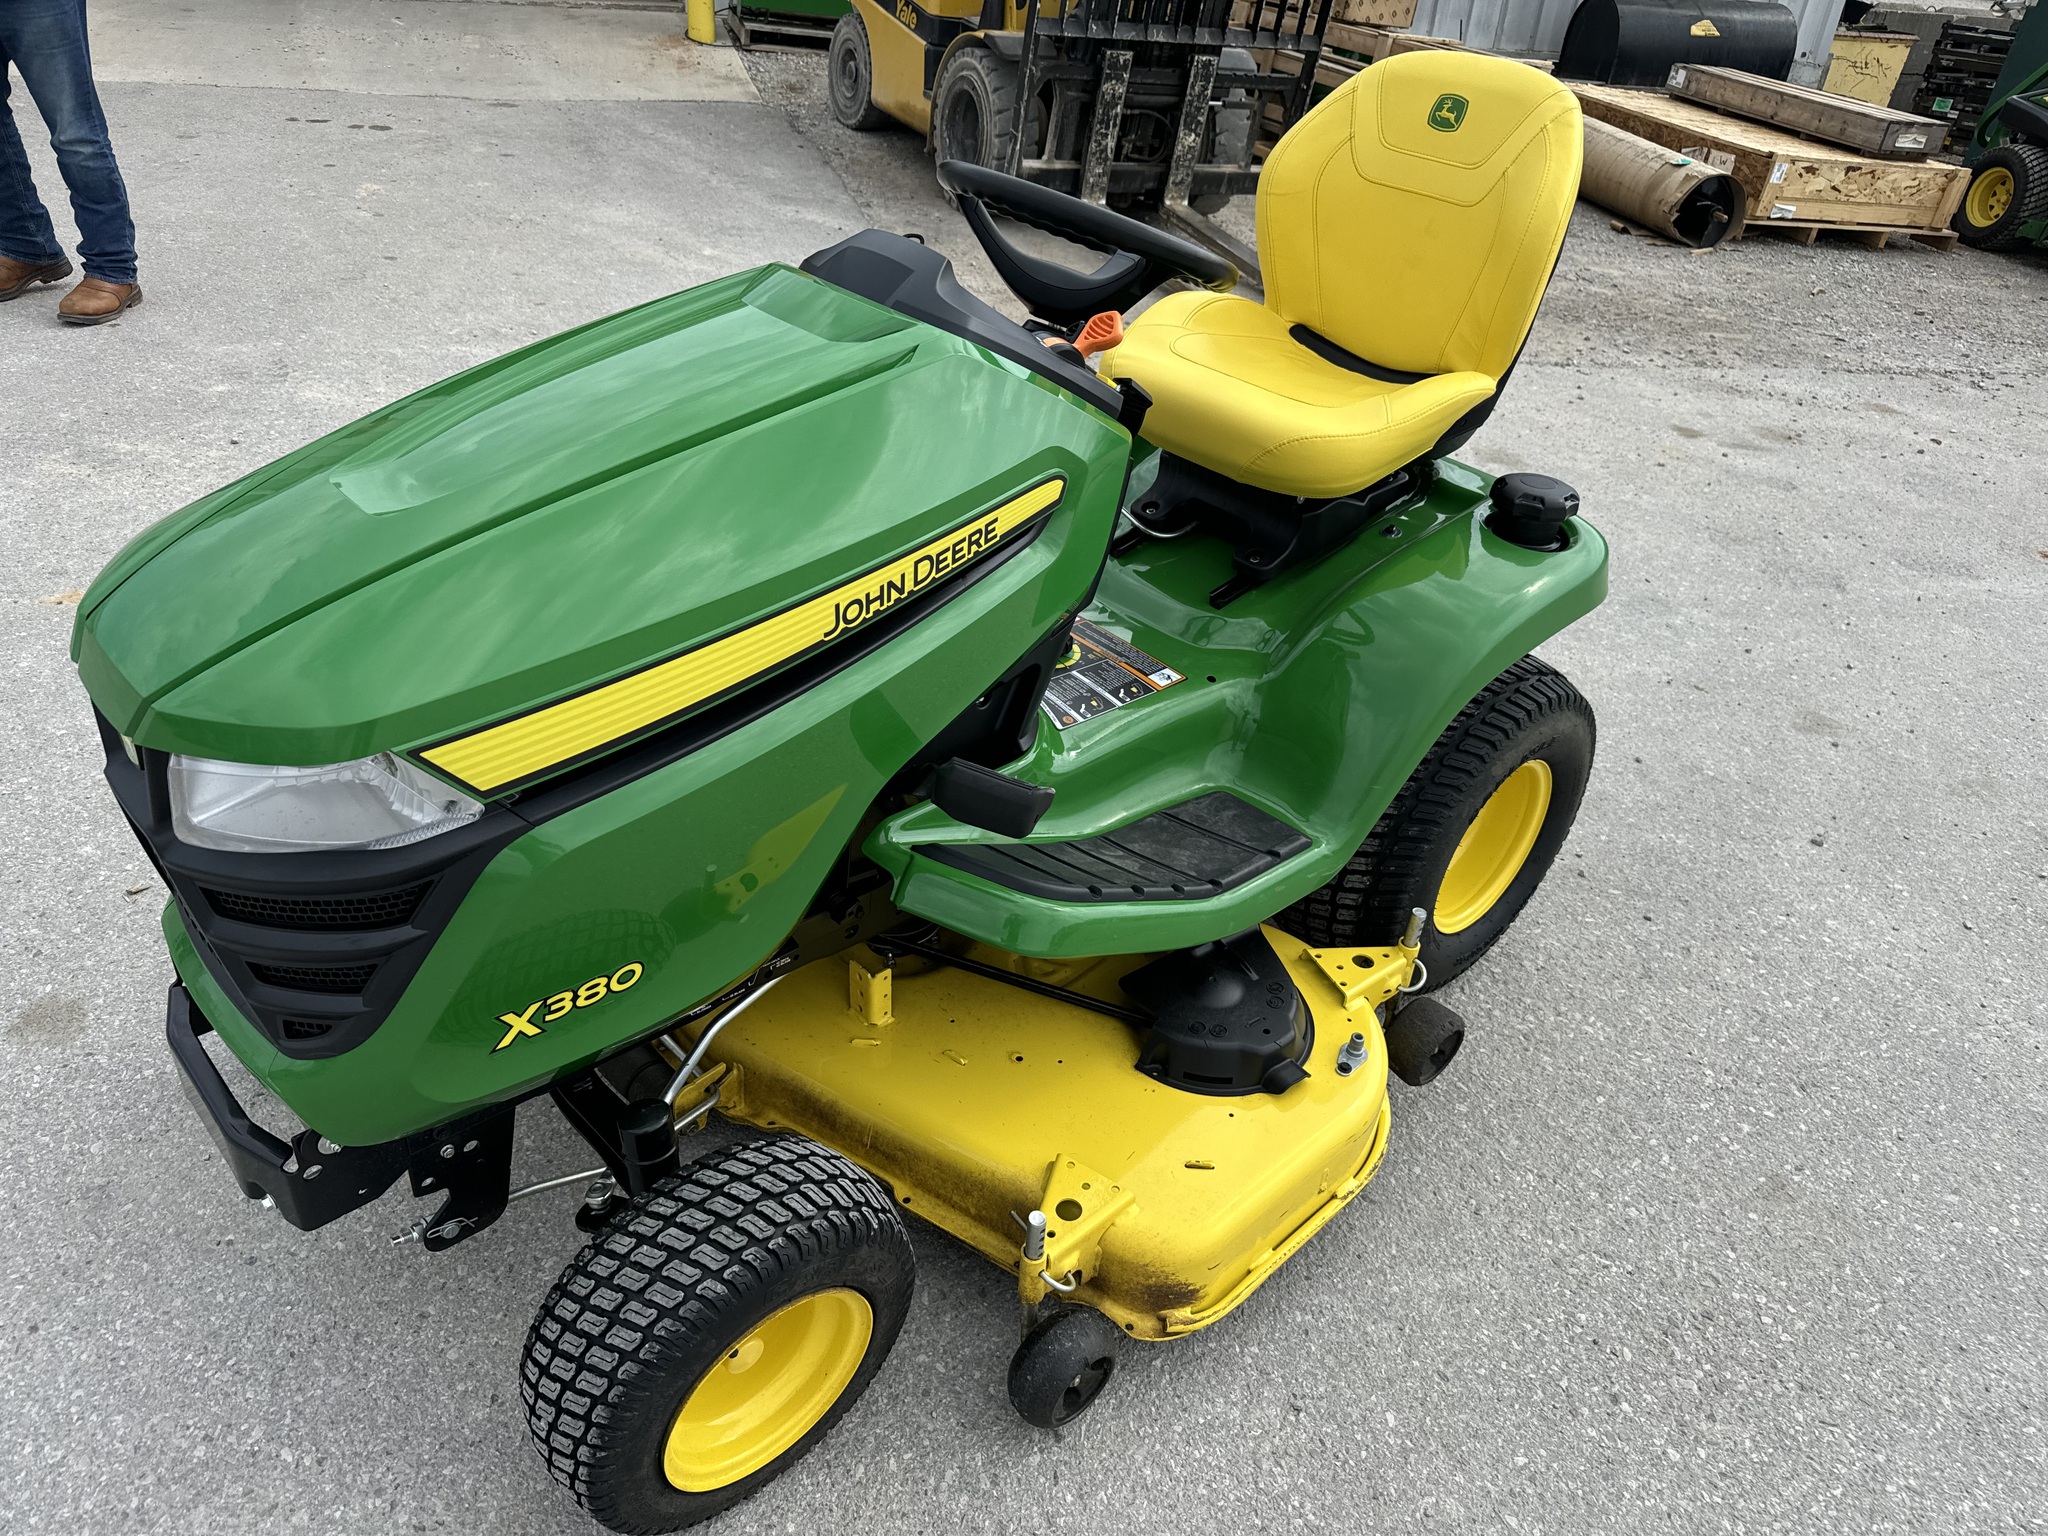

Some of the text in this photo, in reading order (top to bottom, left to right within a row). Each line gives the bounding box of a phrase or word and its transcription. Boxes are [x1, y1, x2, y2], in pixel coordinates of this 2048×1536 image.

[896, 0, 917, 29] Yale
[823, 516, 999, 640] JOHN DEERE
[489, 960, 645, 1055] X380
